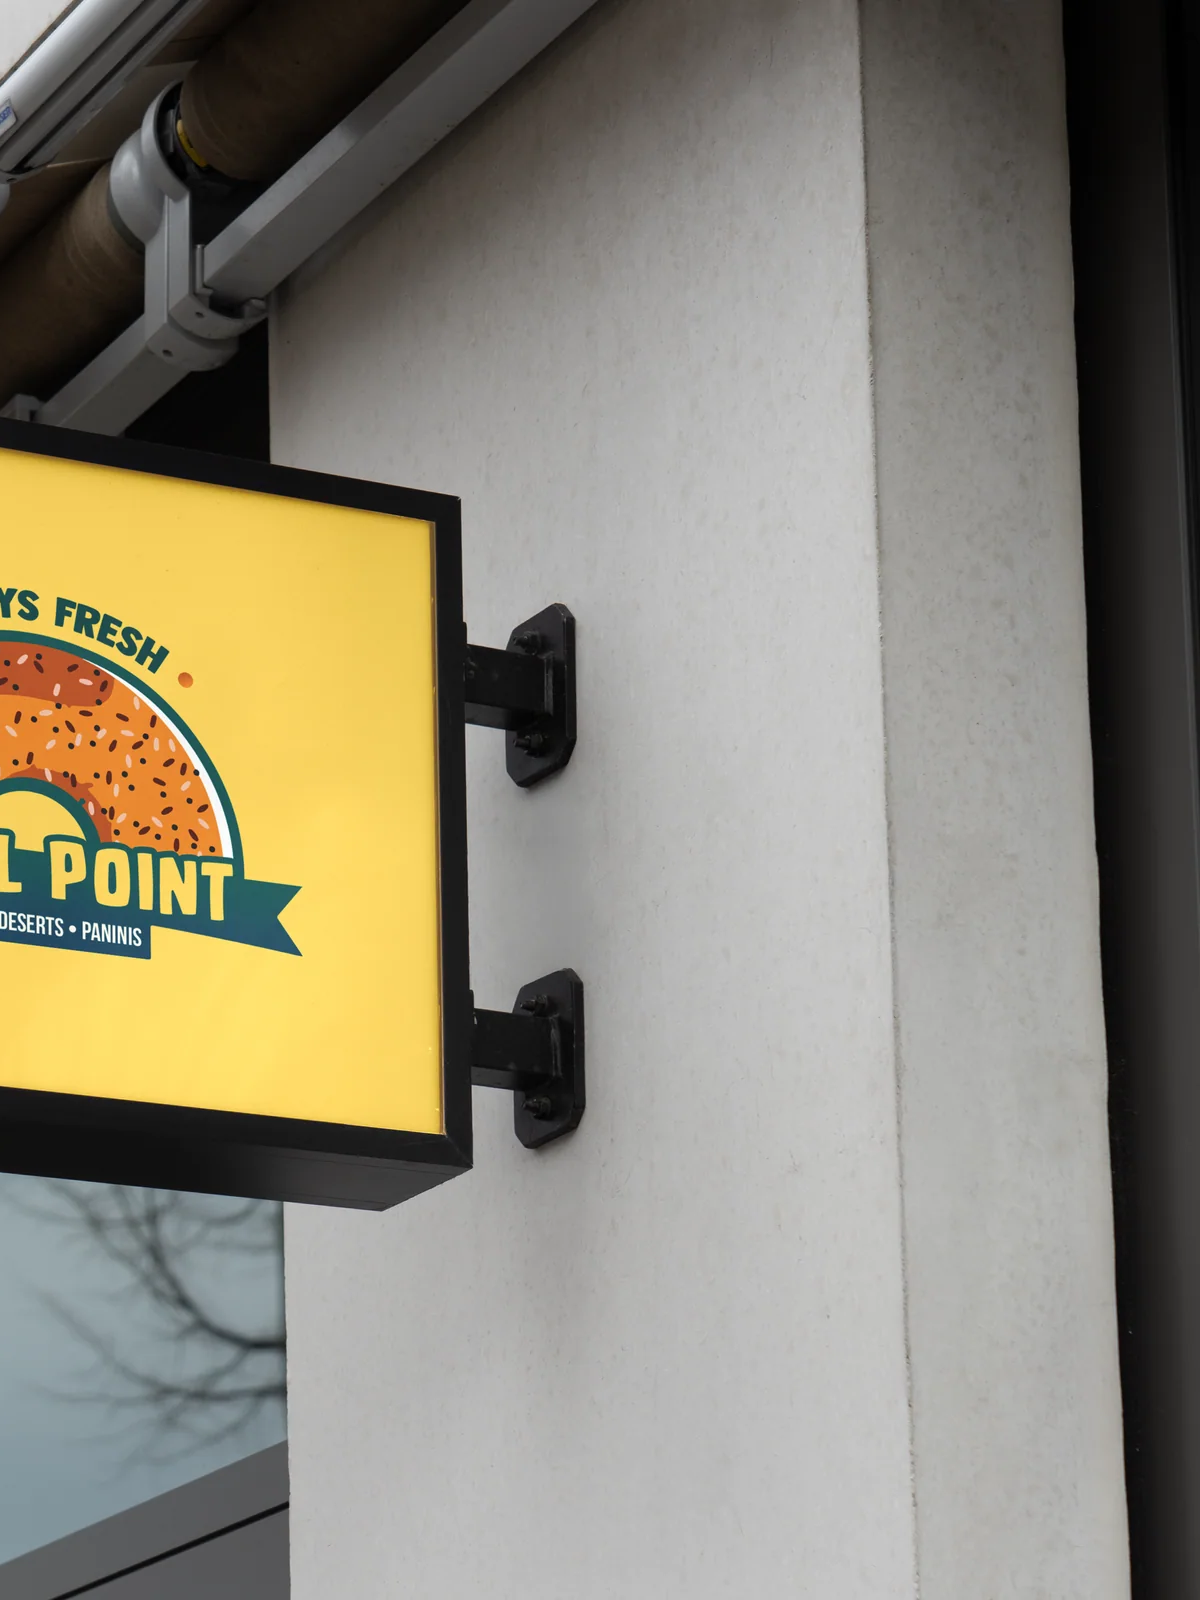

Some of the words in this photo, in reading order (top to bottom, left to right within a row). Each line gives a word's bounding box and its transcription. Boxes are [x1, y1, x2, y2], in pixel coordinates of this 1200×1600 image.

[54, 597, 169, 673] FRESH
[49, 840, 234, 921] POINT
[81, 920, 143, 947] PANINIS
